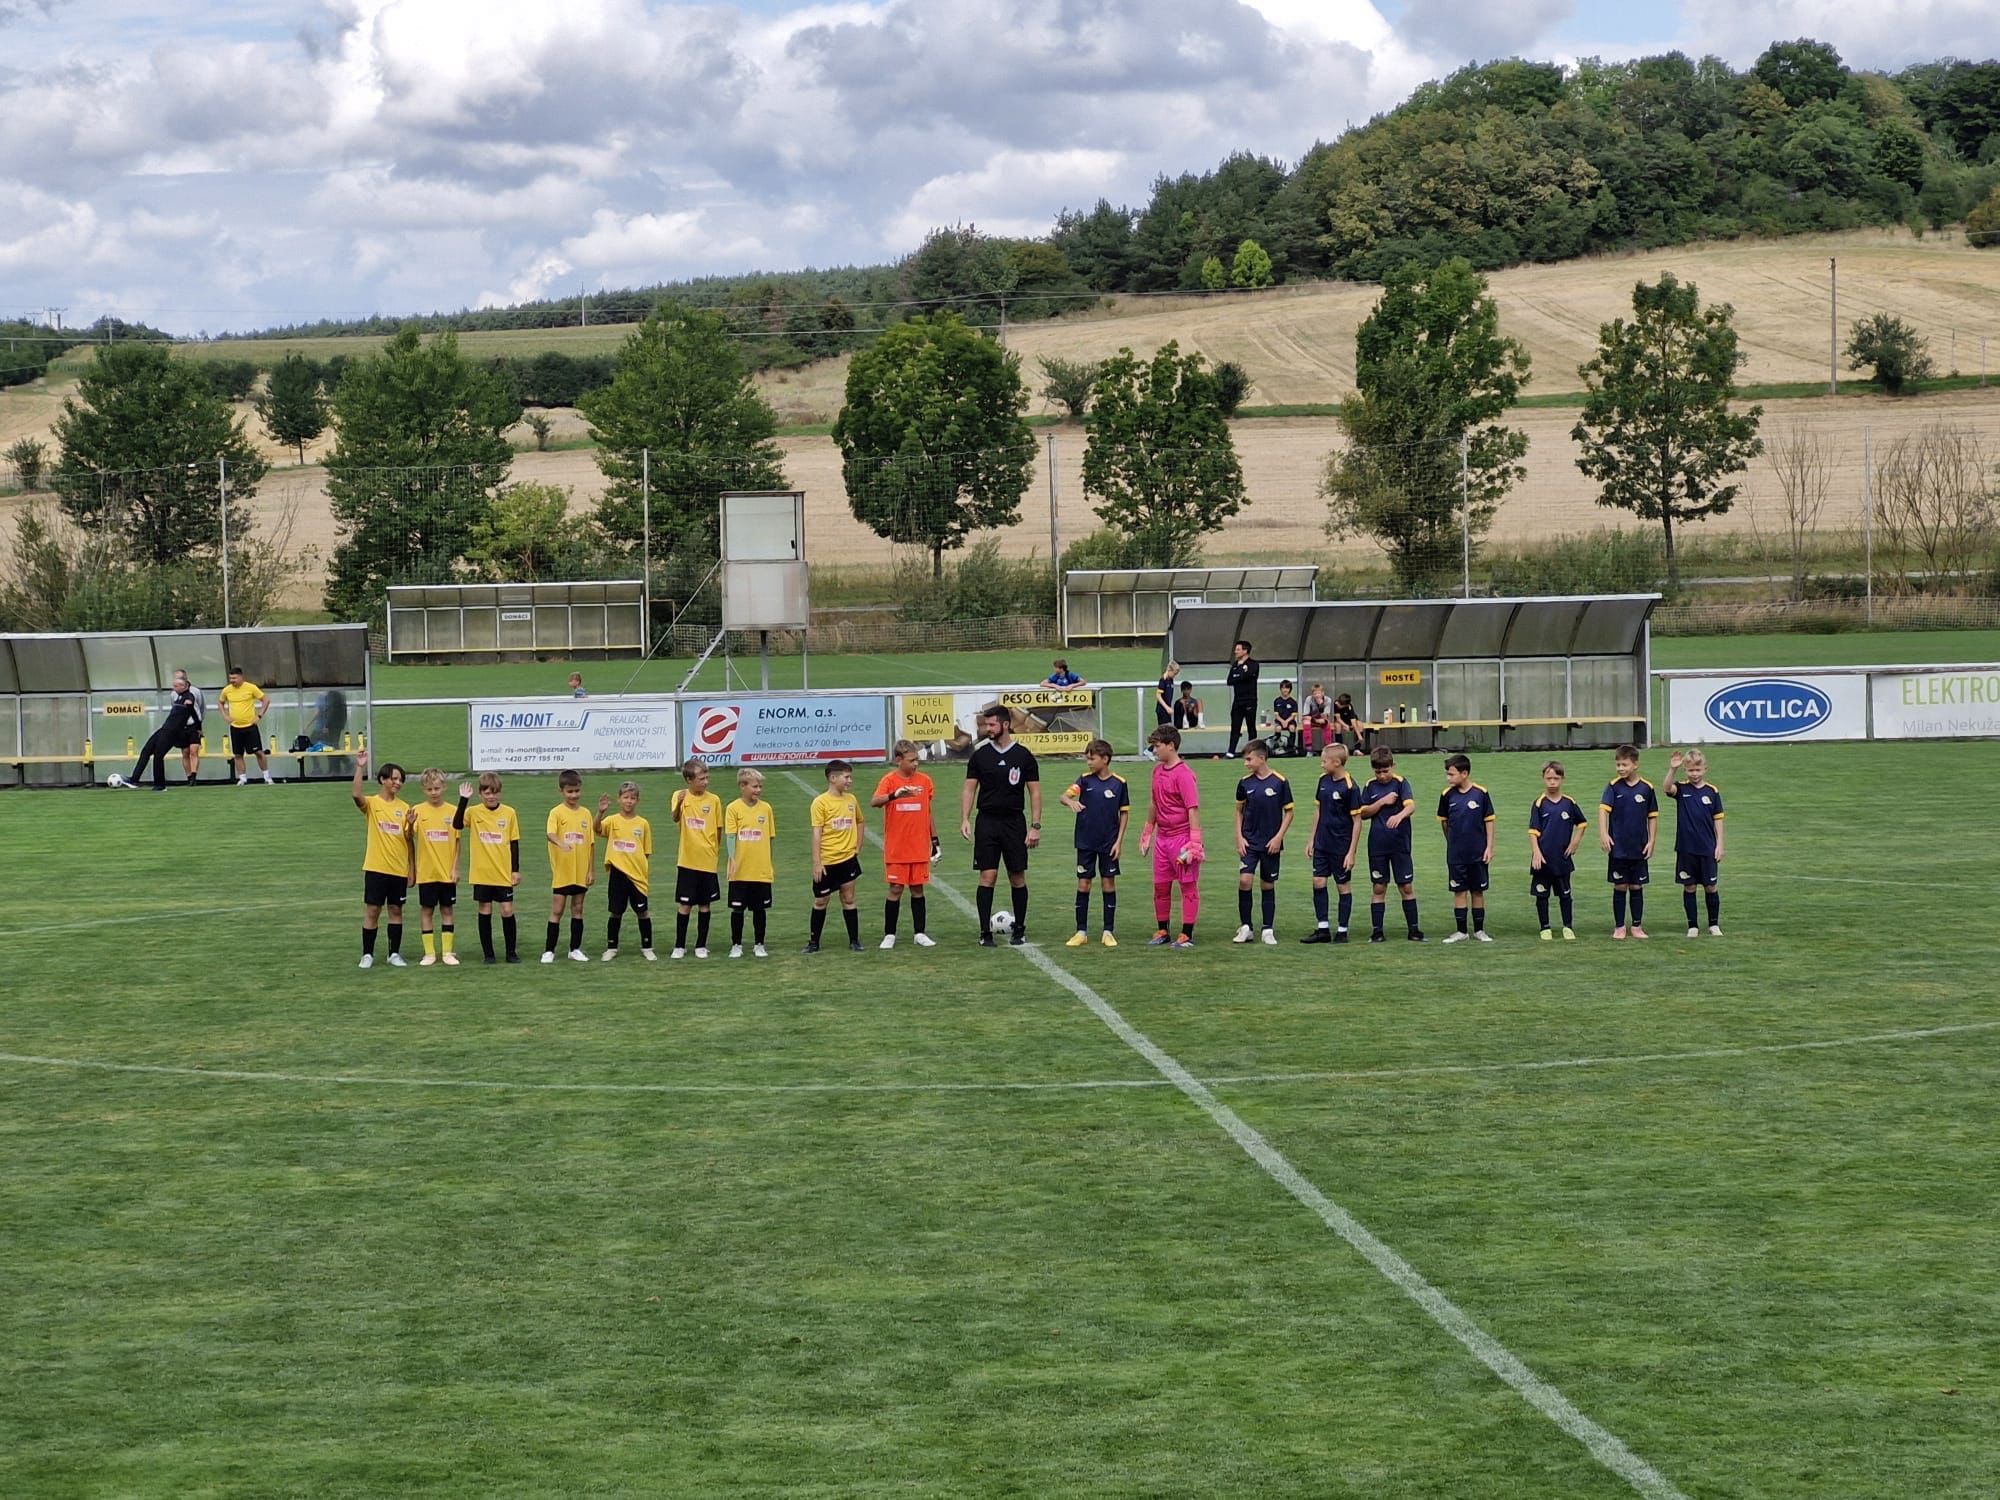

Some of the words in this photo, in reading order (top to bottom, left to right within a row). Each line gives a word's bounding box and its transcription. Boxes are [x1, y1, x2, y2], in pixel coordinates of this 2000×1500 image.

[1902, 676, 2000, 705] ELEKTRO
[912, 697, 944, 707] HOTEL
[1002, 693, 1032, 704] PESO
[1065, 694, 1089, 702] s.r.o.
[106, 704, 142, 714] DOMÁCÍ
[758, 707, 810, 719] ENORM,
[815, 708, 837, 717] a.s.
[1719, 699, 1821, 719] KYTLICA
[480, 713, 554, 728] RIS-MONT
[609, 714, 649, 724] REALIZACE
[906, 711, 950, 725] SLÁVIA
[756, 723, 839, 735] Elektromontážní
[840, 721, 872, 733] práce
[1903, 720, 1943, 733] Milan
[832, 739, 851, 747] Brno
[1033, 735, 1050, 743] 725
[1052, 734, 1069, 742] 999
[1071, 734, 1089, 742] 390
[636, 751, 666, 760] OPRAVY
[750, 751, 819, 760] www.enorm.cz
